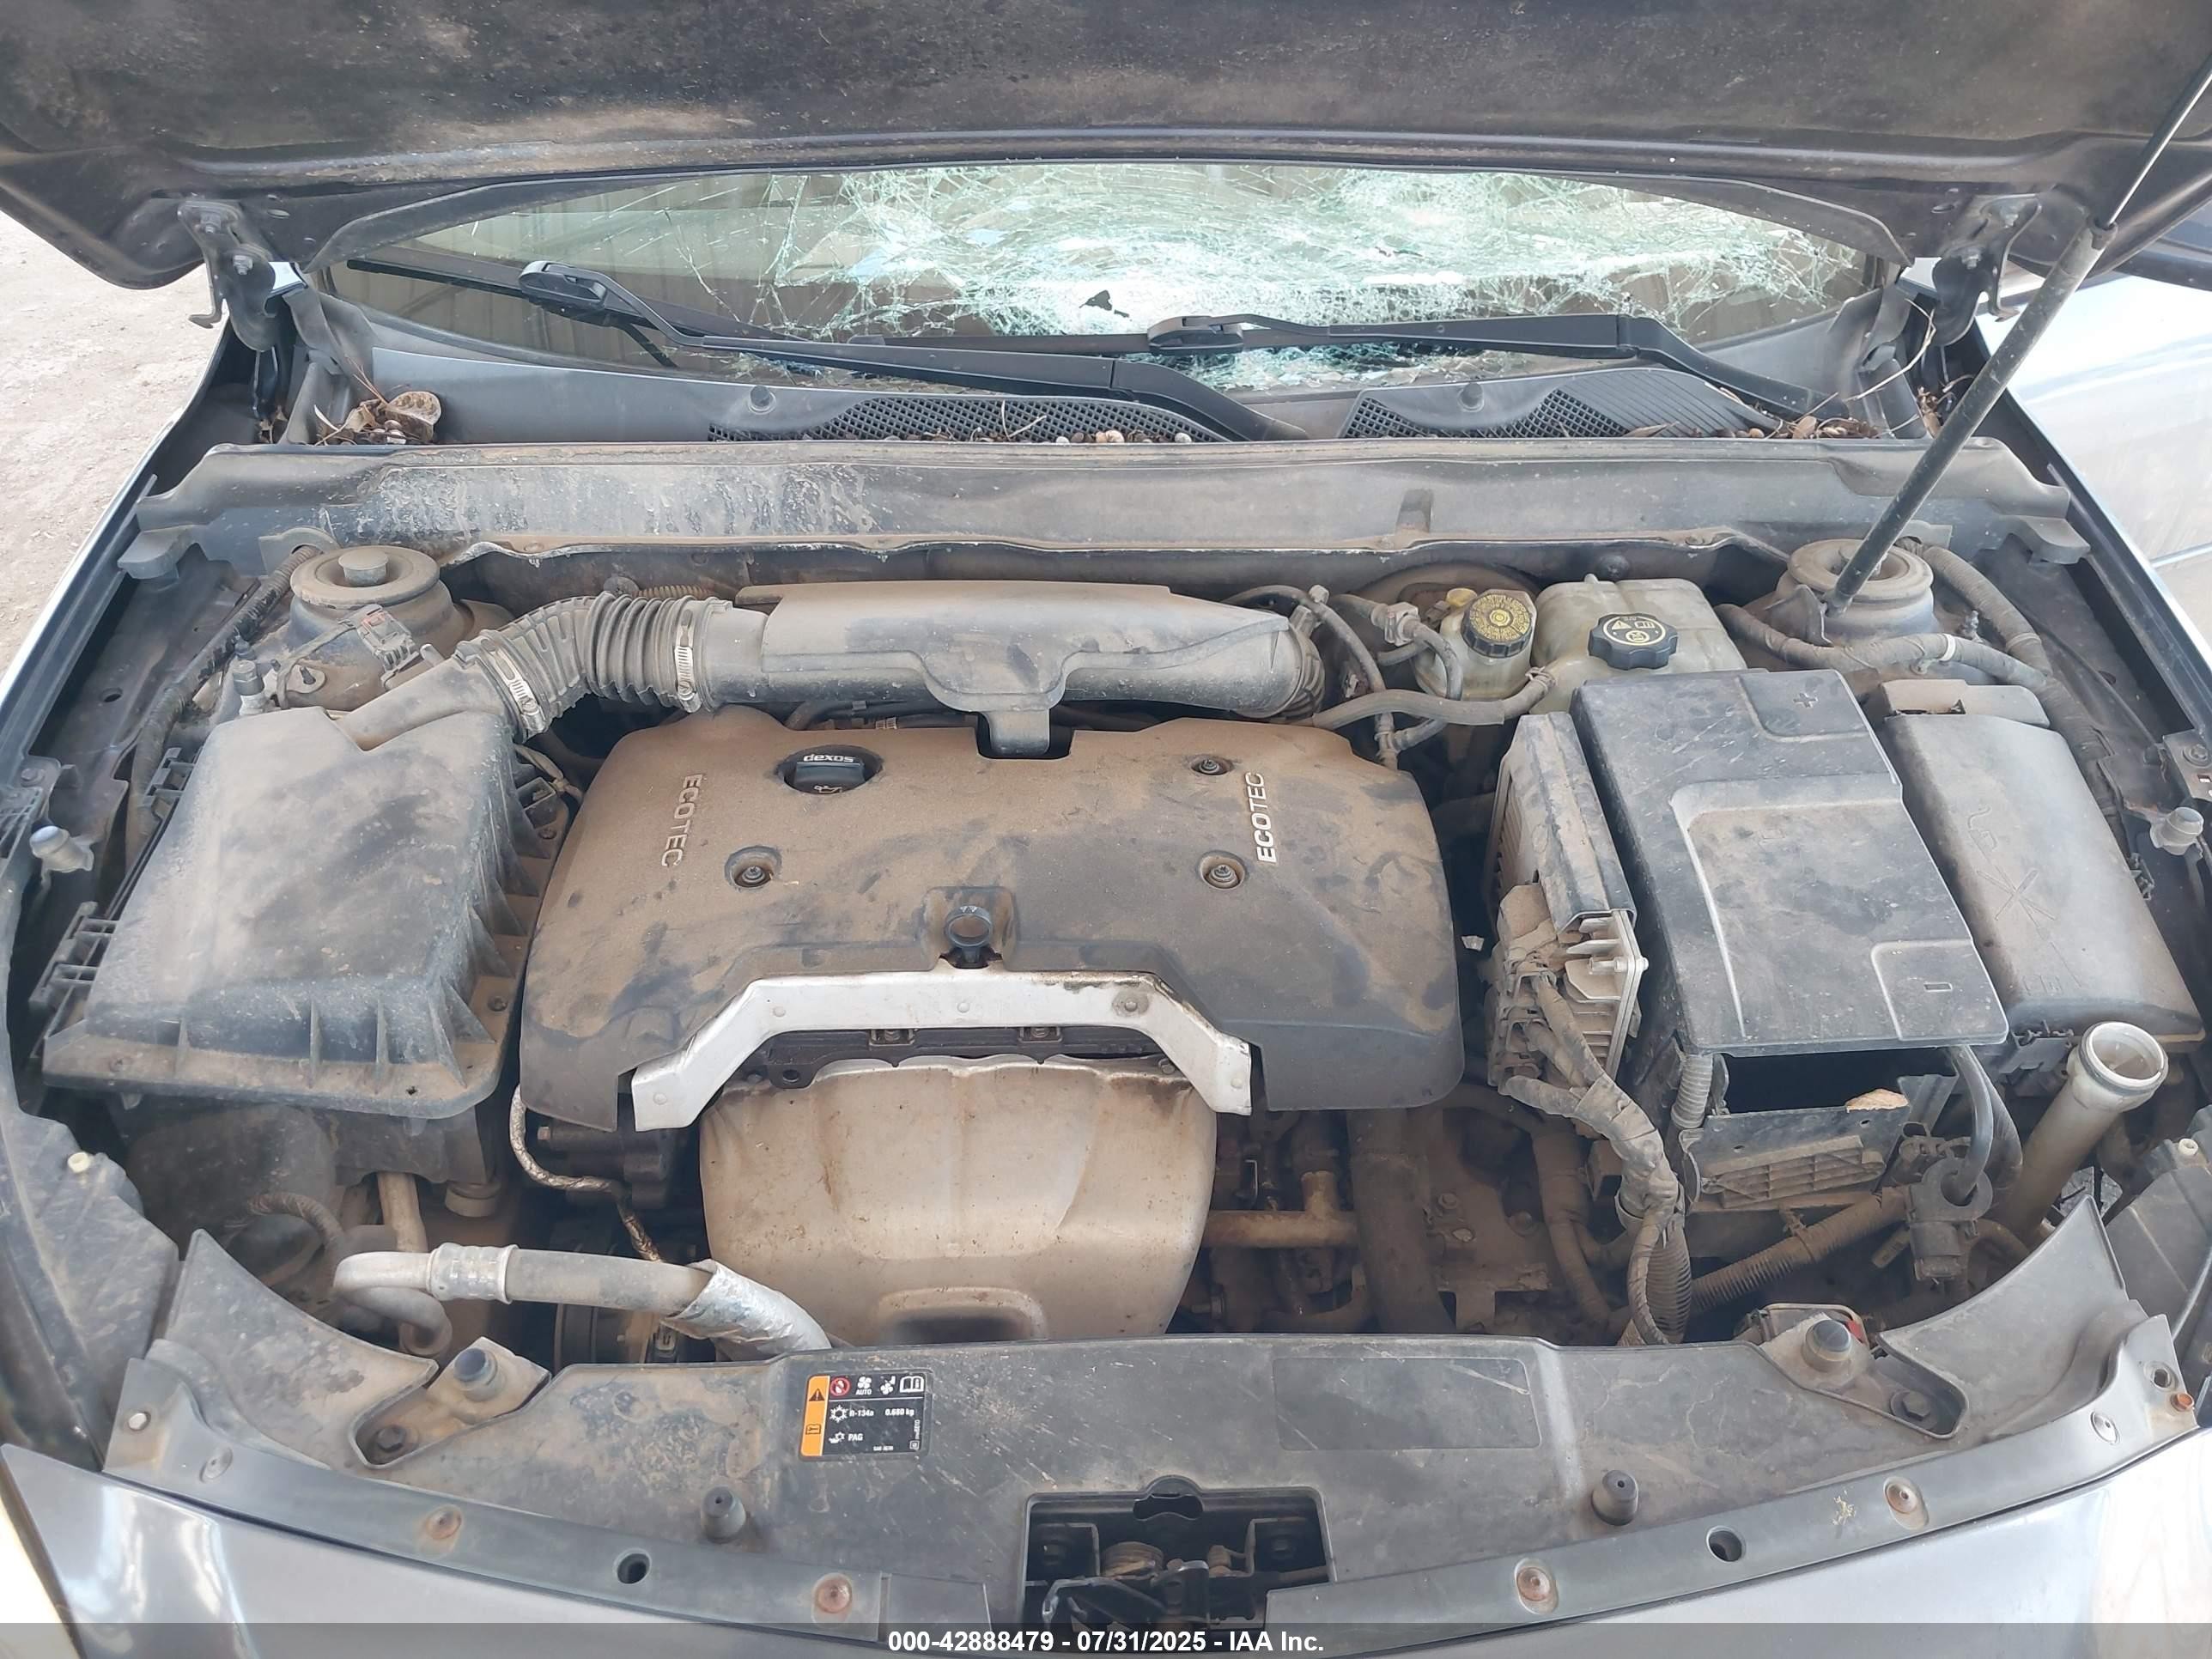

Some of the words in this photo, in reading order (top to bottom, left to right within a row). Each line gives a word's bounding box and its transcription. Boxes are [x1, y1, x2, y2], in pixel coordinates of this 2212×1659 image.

[803, 754, 854, 763] dexos
[661, 774, 703, 866] ECOTEC
[1245, 772, 1277, 863] ECOTEC
